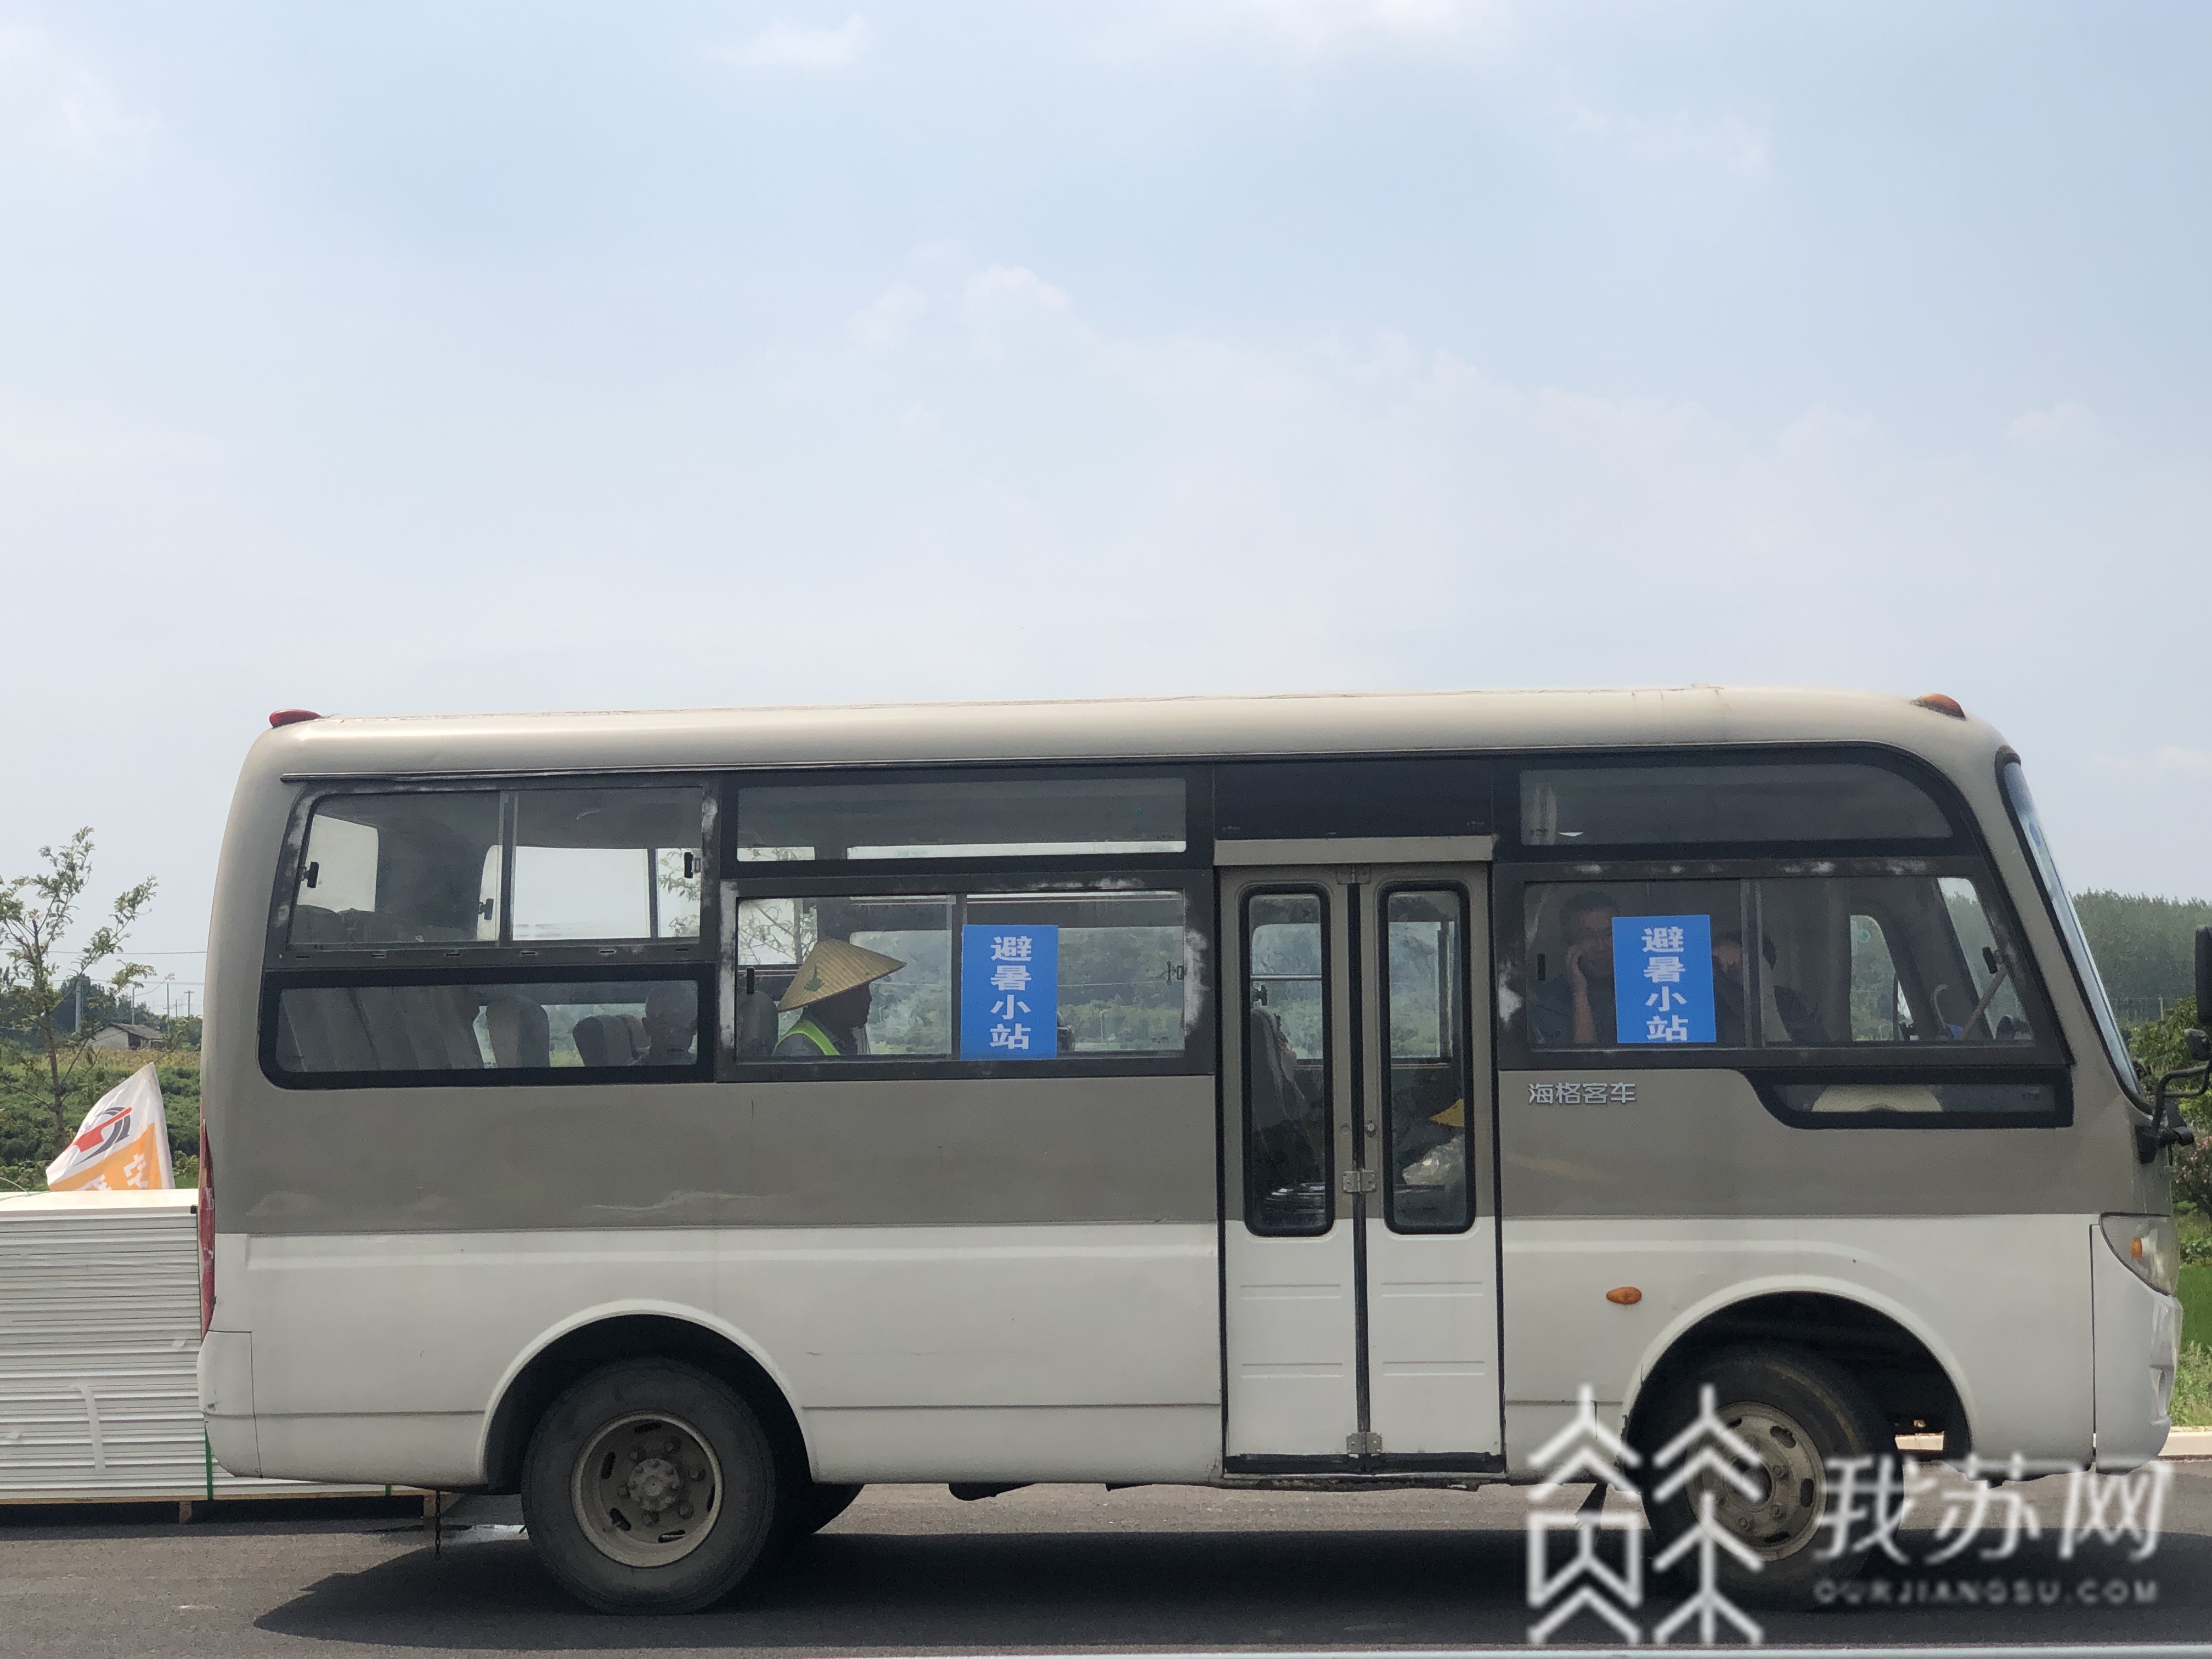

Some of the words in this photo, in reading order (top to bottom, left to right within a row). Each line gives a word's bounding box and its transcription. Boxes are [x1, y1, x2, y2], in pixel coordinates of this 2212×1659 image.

[989, 935, 1032, 1049] 避暑小站
[1641, 926, 1689, 1041] 避暑小站
[1528, 1082, 1637, 1104] 海格客车
